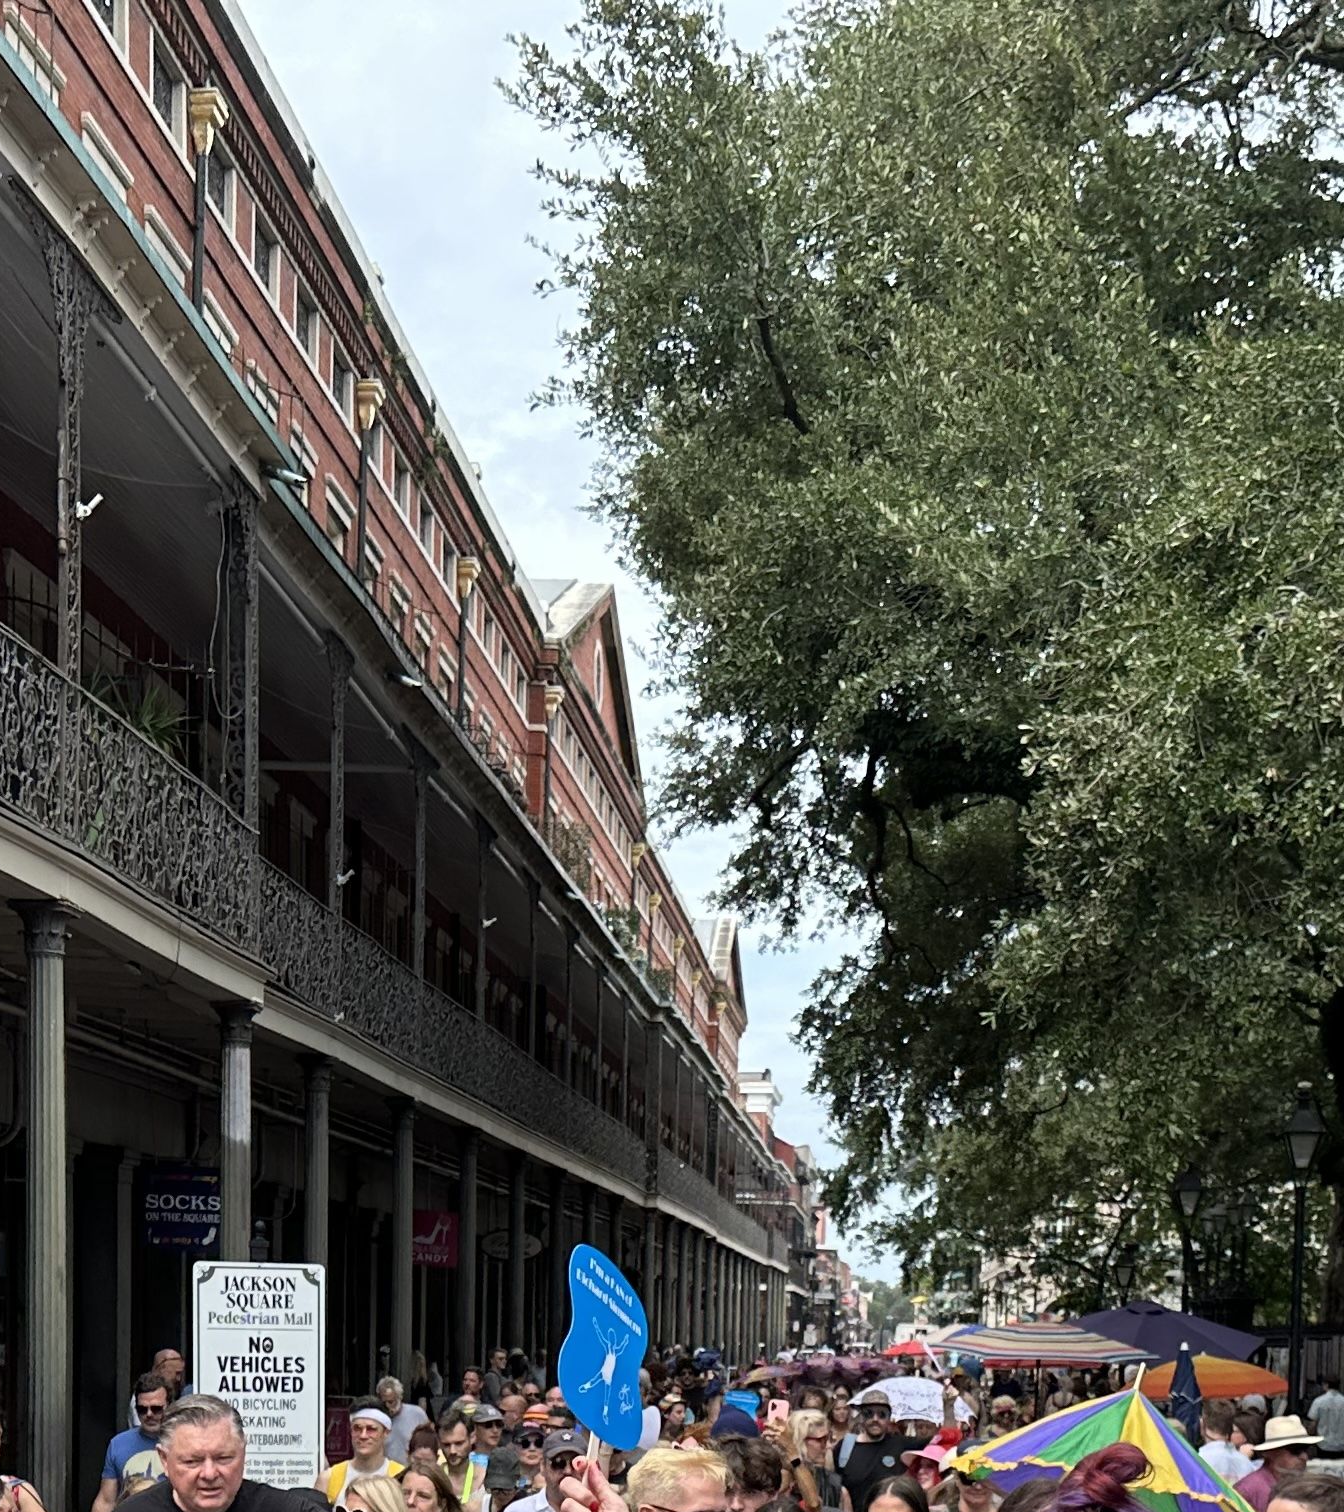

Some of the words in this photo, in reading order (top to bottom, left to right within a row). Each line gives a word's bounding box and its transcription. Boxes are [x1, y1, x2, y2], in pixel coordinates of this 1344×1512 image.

[146, 1193, 221, 1211] SOCKS
[146, 1212, 159, 1221] ON
[161, 1212, 181, 1222] THE
[183, 1213, 221, 1224] SQUARE
[220, 1275, 297, 1295] JACKSON
[226, 1292, 295, 1312] SQUARE
[208, 1311, 280, 1325] Pedestrian
[284, 1312, 313, 1326] Mall
[248, 1336, 274, 1354] NO
[217, 1355, 306, 1374] VEHICLES
[218, 1375, 304, 1393] ALLOWED
[242, 1398, 297, 1411] BICYCLING
[242, 1416, 286, 1429] SKATING
[246, 1433, 303, 1446] ATEBOARDING
